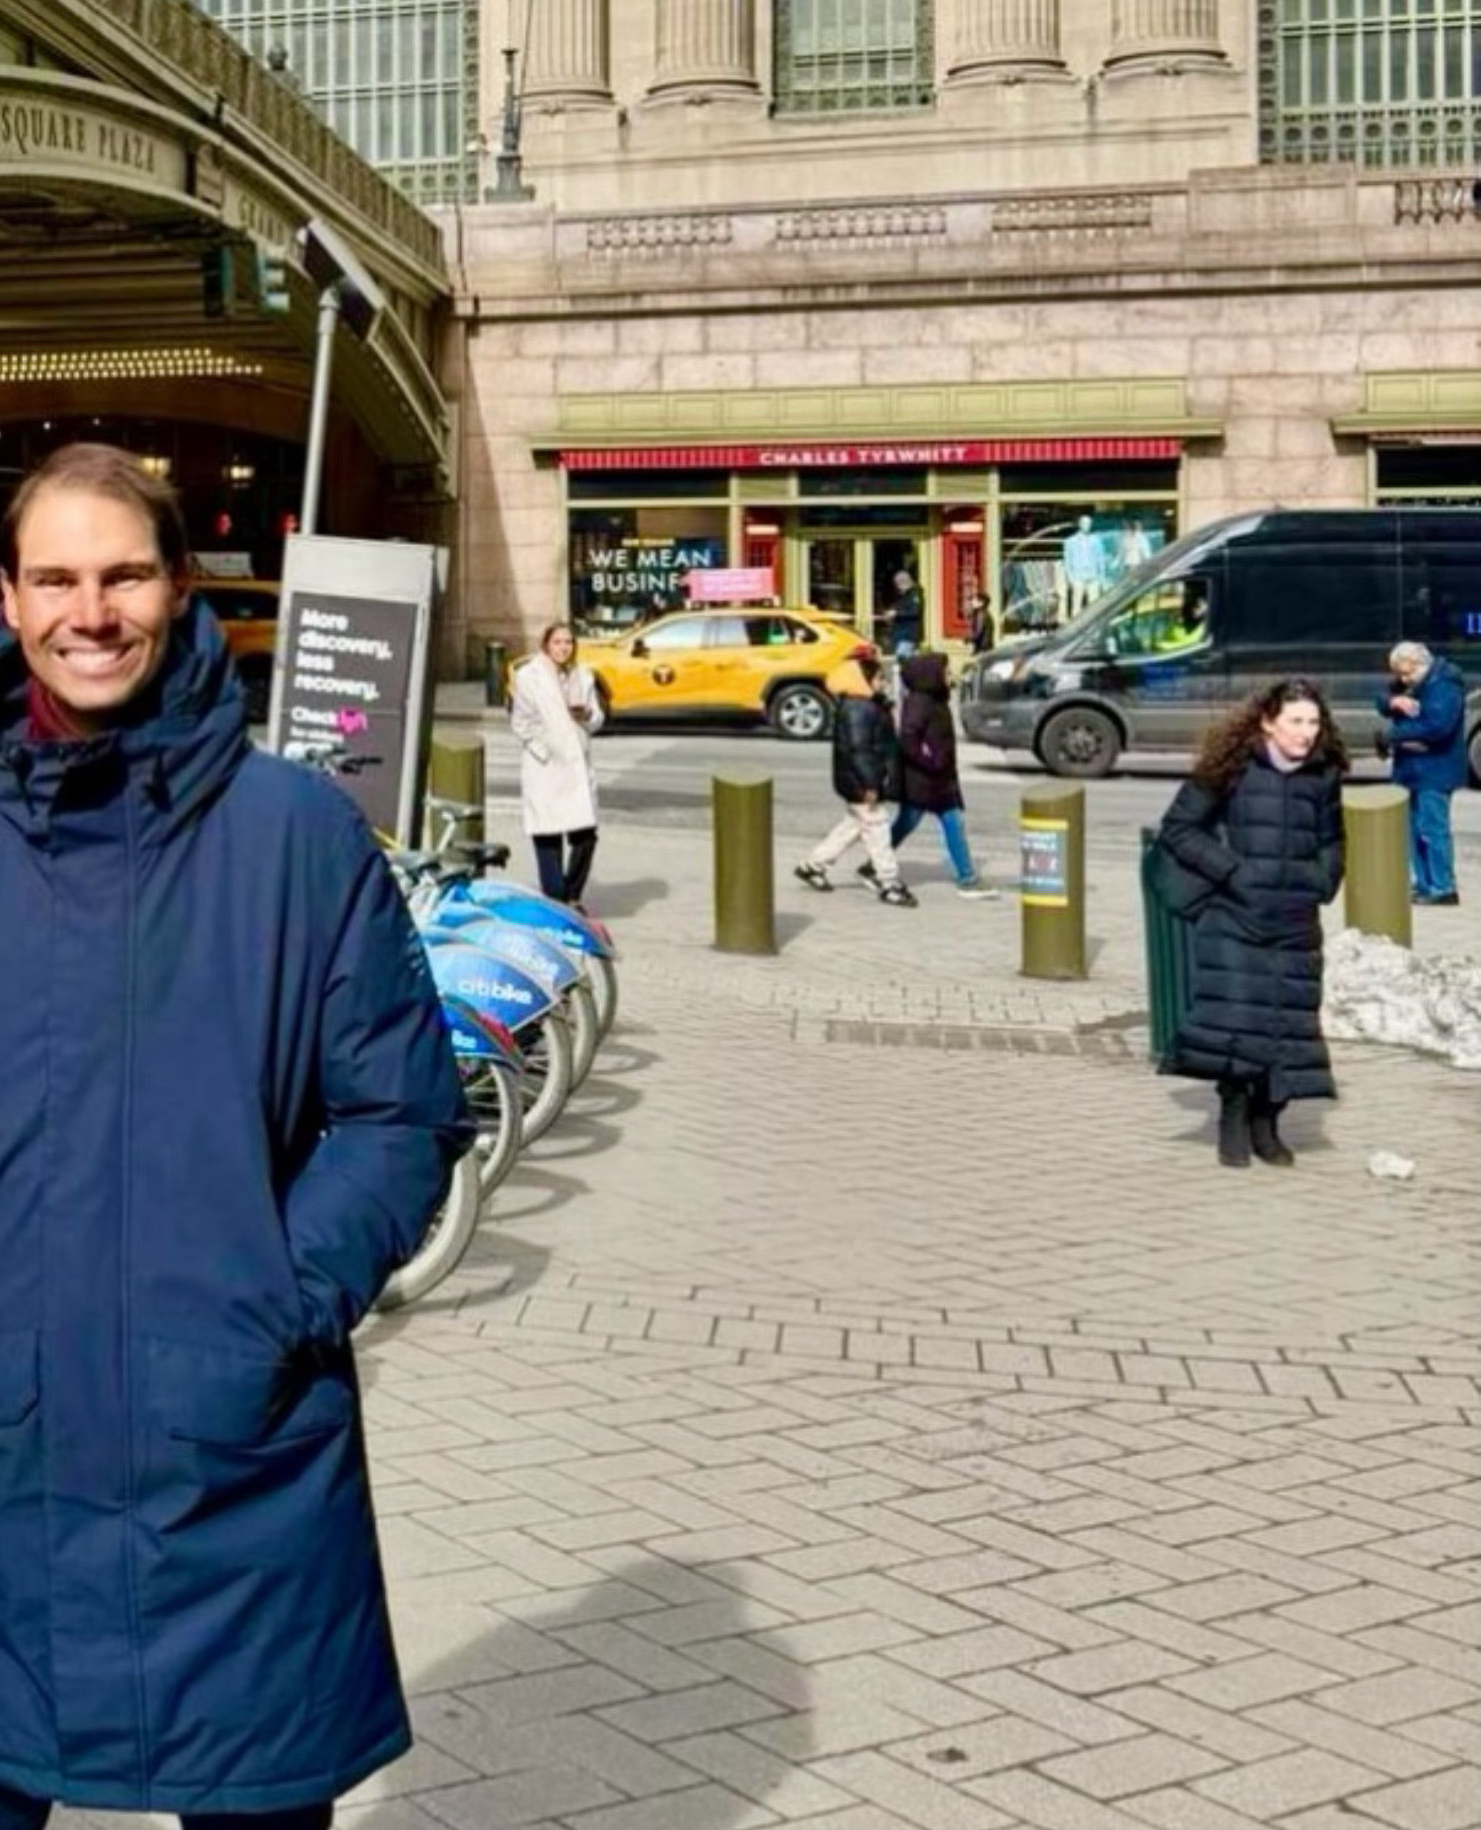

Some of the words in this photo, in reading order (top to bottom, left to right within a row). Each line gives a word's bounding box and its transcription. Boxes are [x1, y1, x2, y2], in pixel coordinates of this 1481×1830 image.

[1, 104, 86, 154] SQUARE
[97, 123, 156, 174] PLAZA
[759, 450, 850, 466] CHARLES
[857, 446, 970, 464] TYRWHITT
[589, 548, 628, 567] WE
[637, 548, 712, 567] MEAN
[300, 608, 349, 632] More
